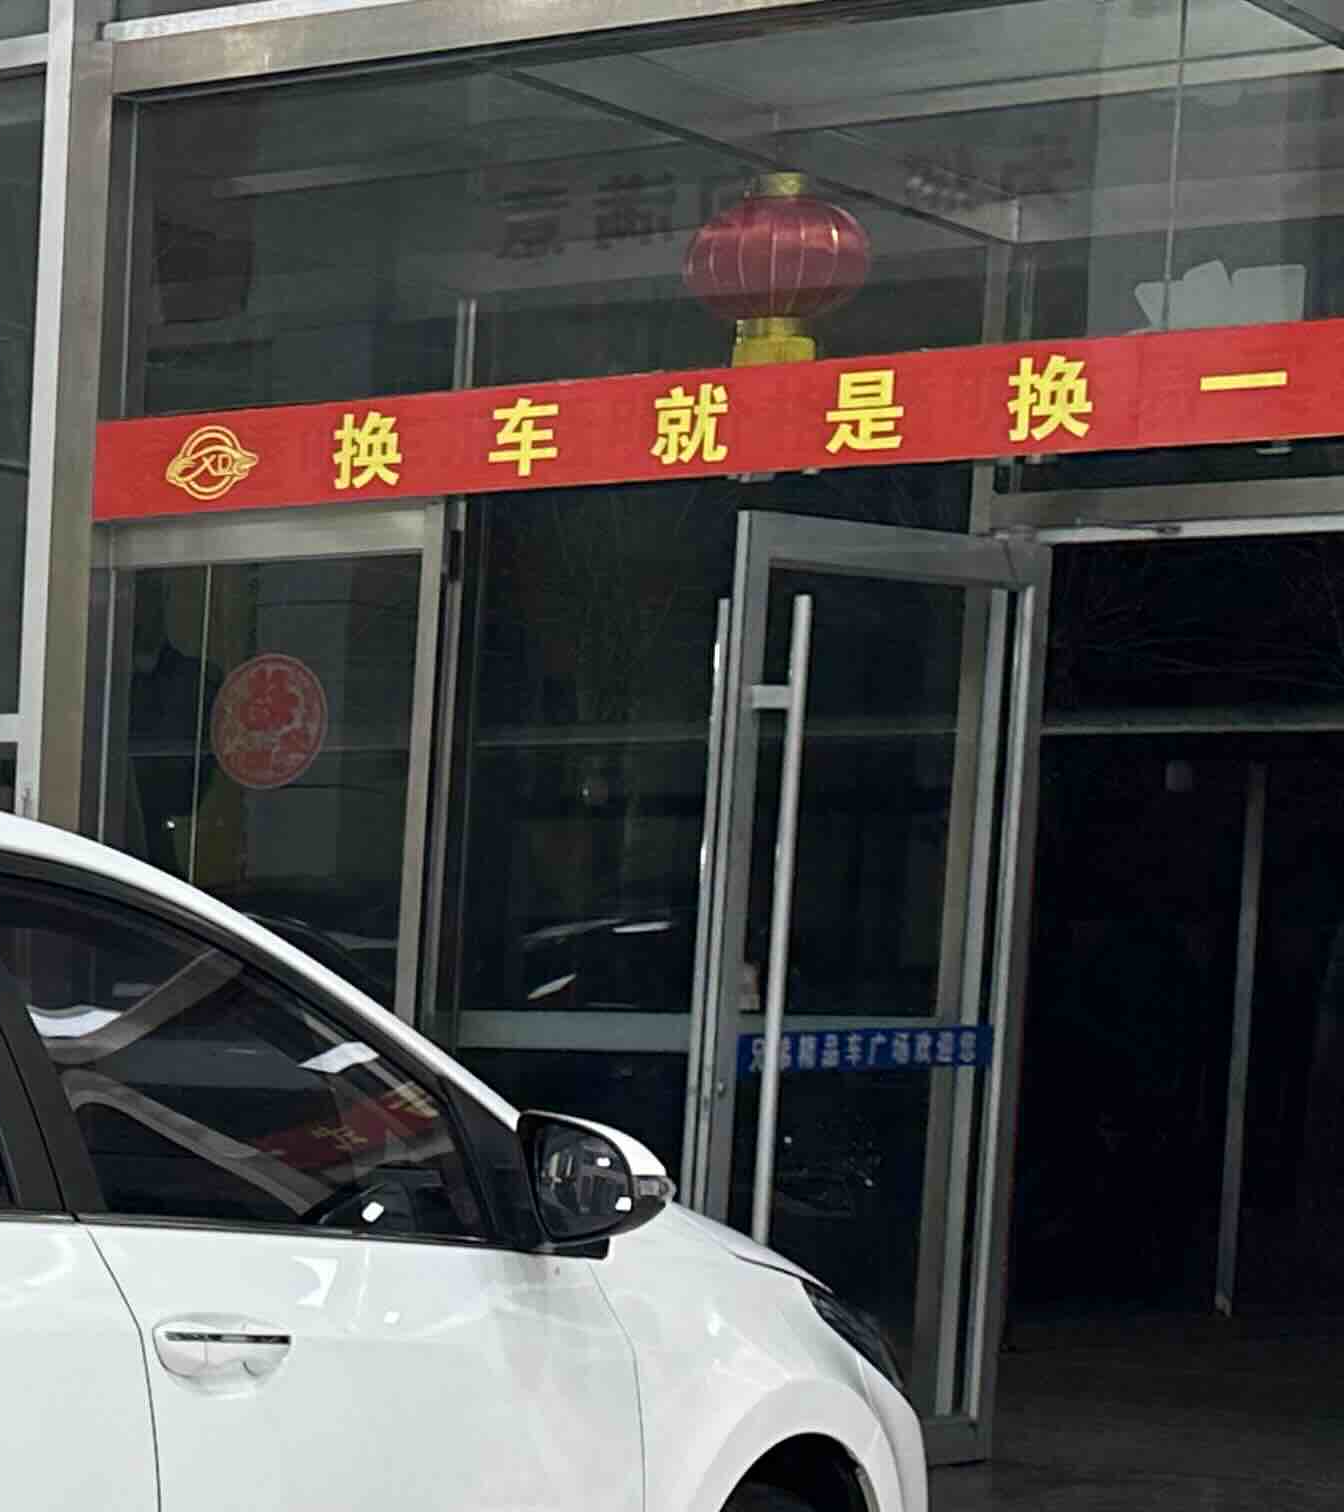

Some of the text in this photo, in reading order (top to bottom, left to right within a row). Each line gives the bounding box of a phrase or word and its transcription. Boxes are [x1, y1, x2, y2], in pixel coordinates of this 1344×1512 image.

[332, 354, 1289, 490] 换车就是换一
